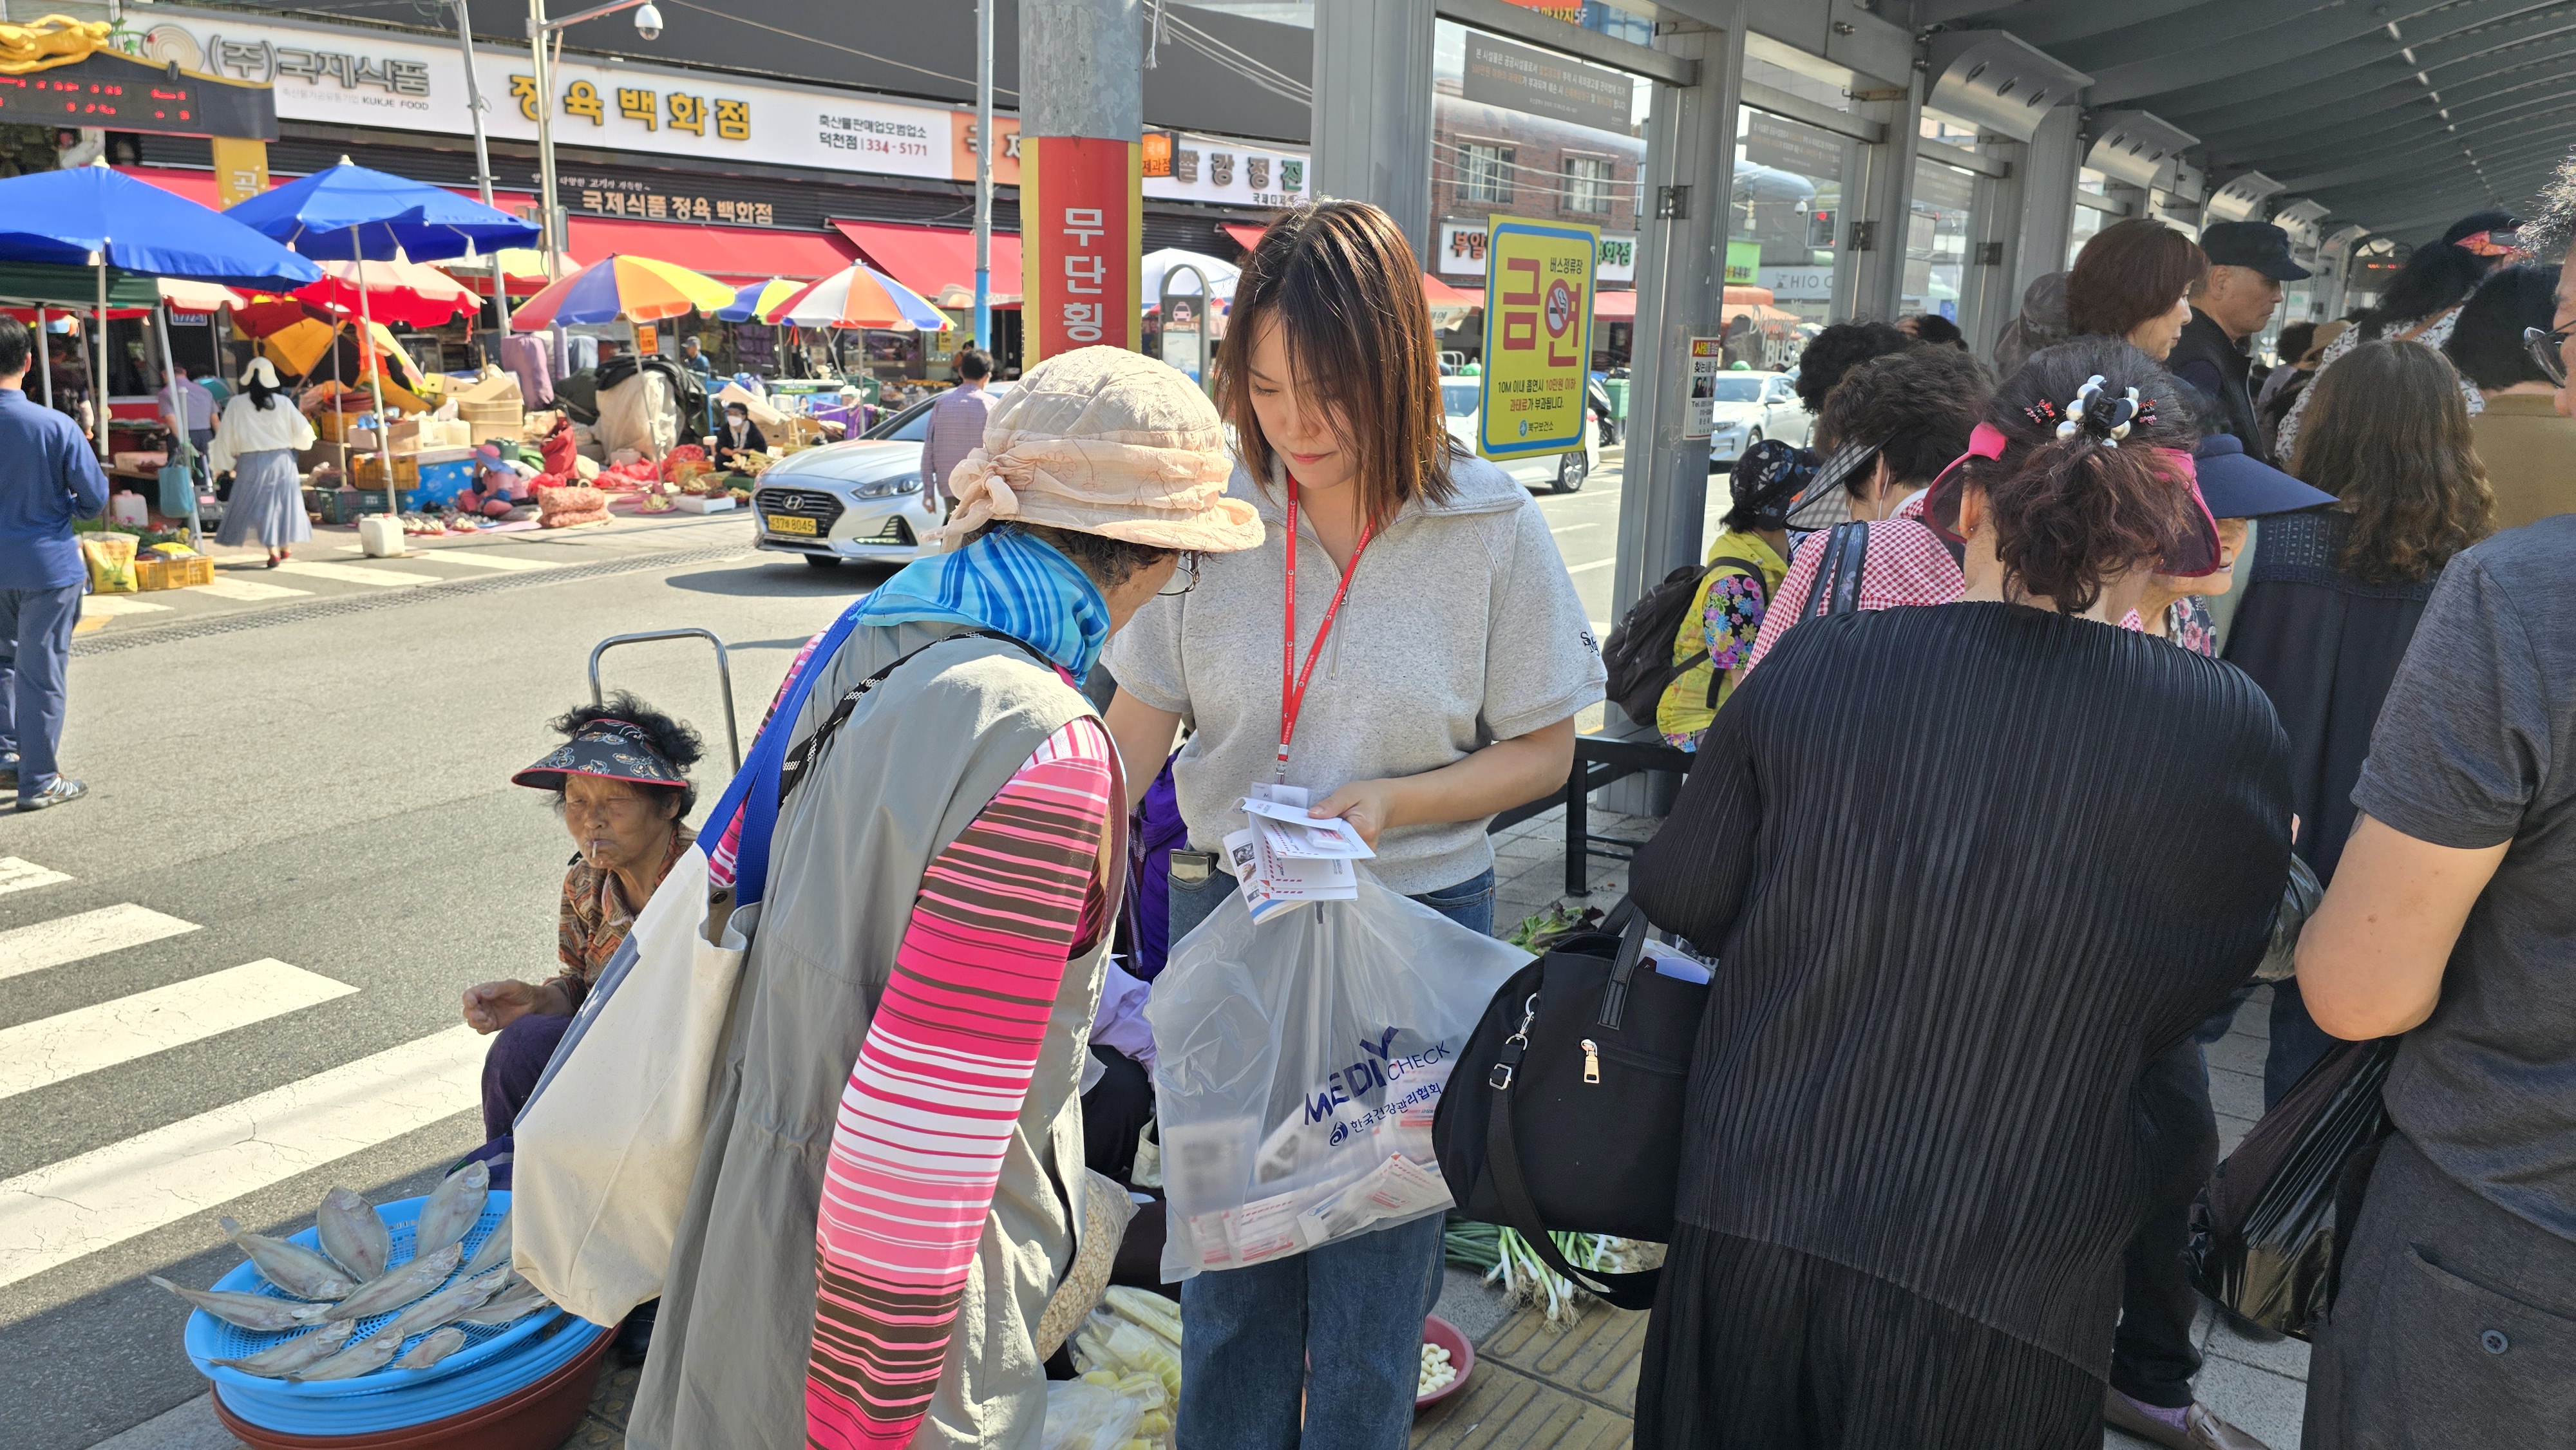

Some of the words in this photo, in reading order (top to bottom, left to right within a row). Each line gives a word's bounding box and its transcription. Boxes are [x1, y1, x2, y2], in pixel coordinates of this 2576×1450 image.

[209, 34, 430, 97] (주)국제식품
[401, 100, 429, 111] FOOD
[819, 132, 858, 150] 덕천점
[582, 190, 667, 219] 국제식품
[672, 196, 712, 221] 정육
[716, 200, 773, 225] 백화점
[1549, 257, 1583, 274] 버스정류장
[1063, 207, 1106, 352] 무단횡
[1502, 257, 1582, 368] 금연
[1498, 381, 1511, 393] 10M
[1513, 380, 1525, 393] 이내
[1526, 379, 1544, 393] 흡연시
[1546, 378, 1564, 391] 10만원
[1565, 377, 1576, 390] 이하
[1510, 397, 1533, 412] 과태료가
[1535, 396, 1564, 411] 부과됩니다.
[1528, 421, 1553, 433] 북구보건소
[791, 519, 813, 532] 8045
[1387, 1040, 1450, 1080] CHECK
[1350, 1082, 1442, 1133] 한국건강관리협회
